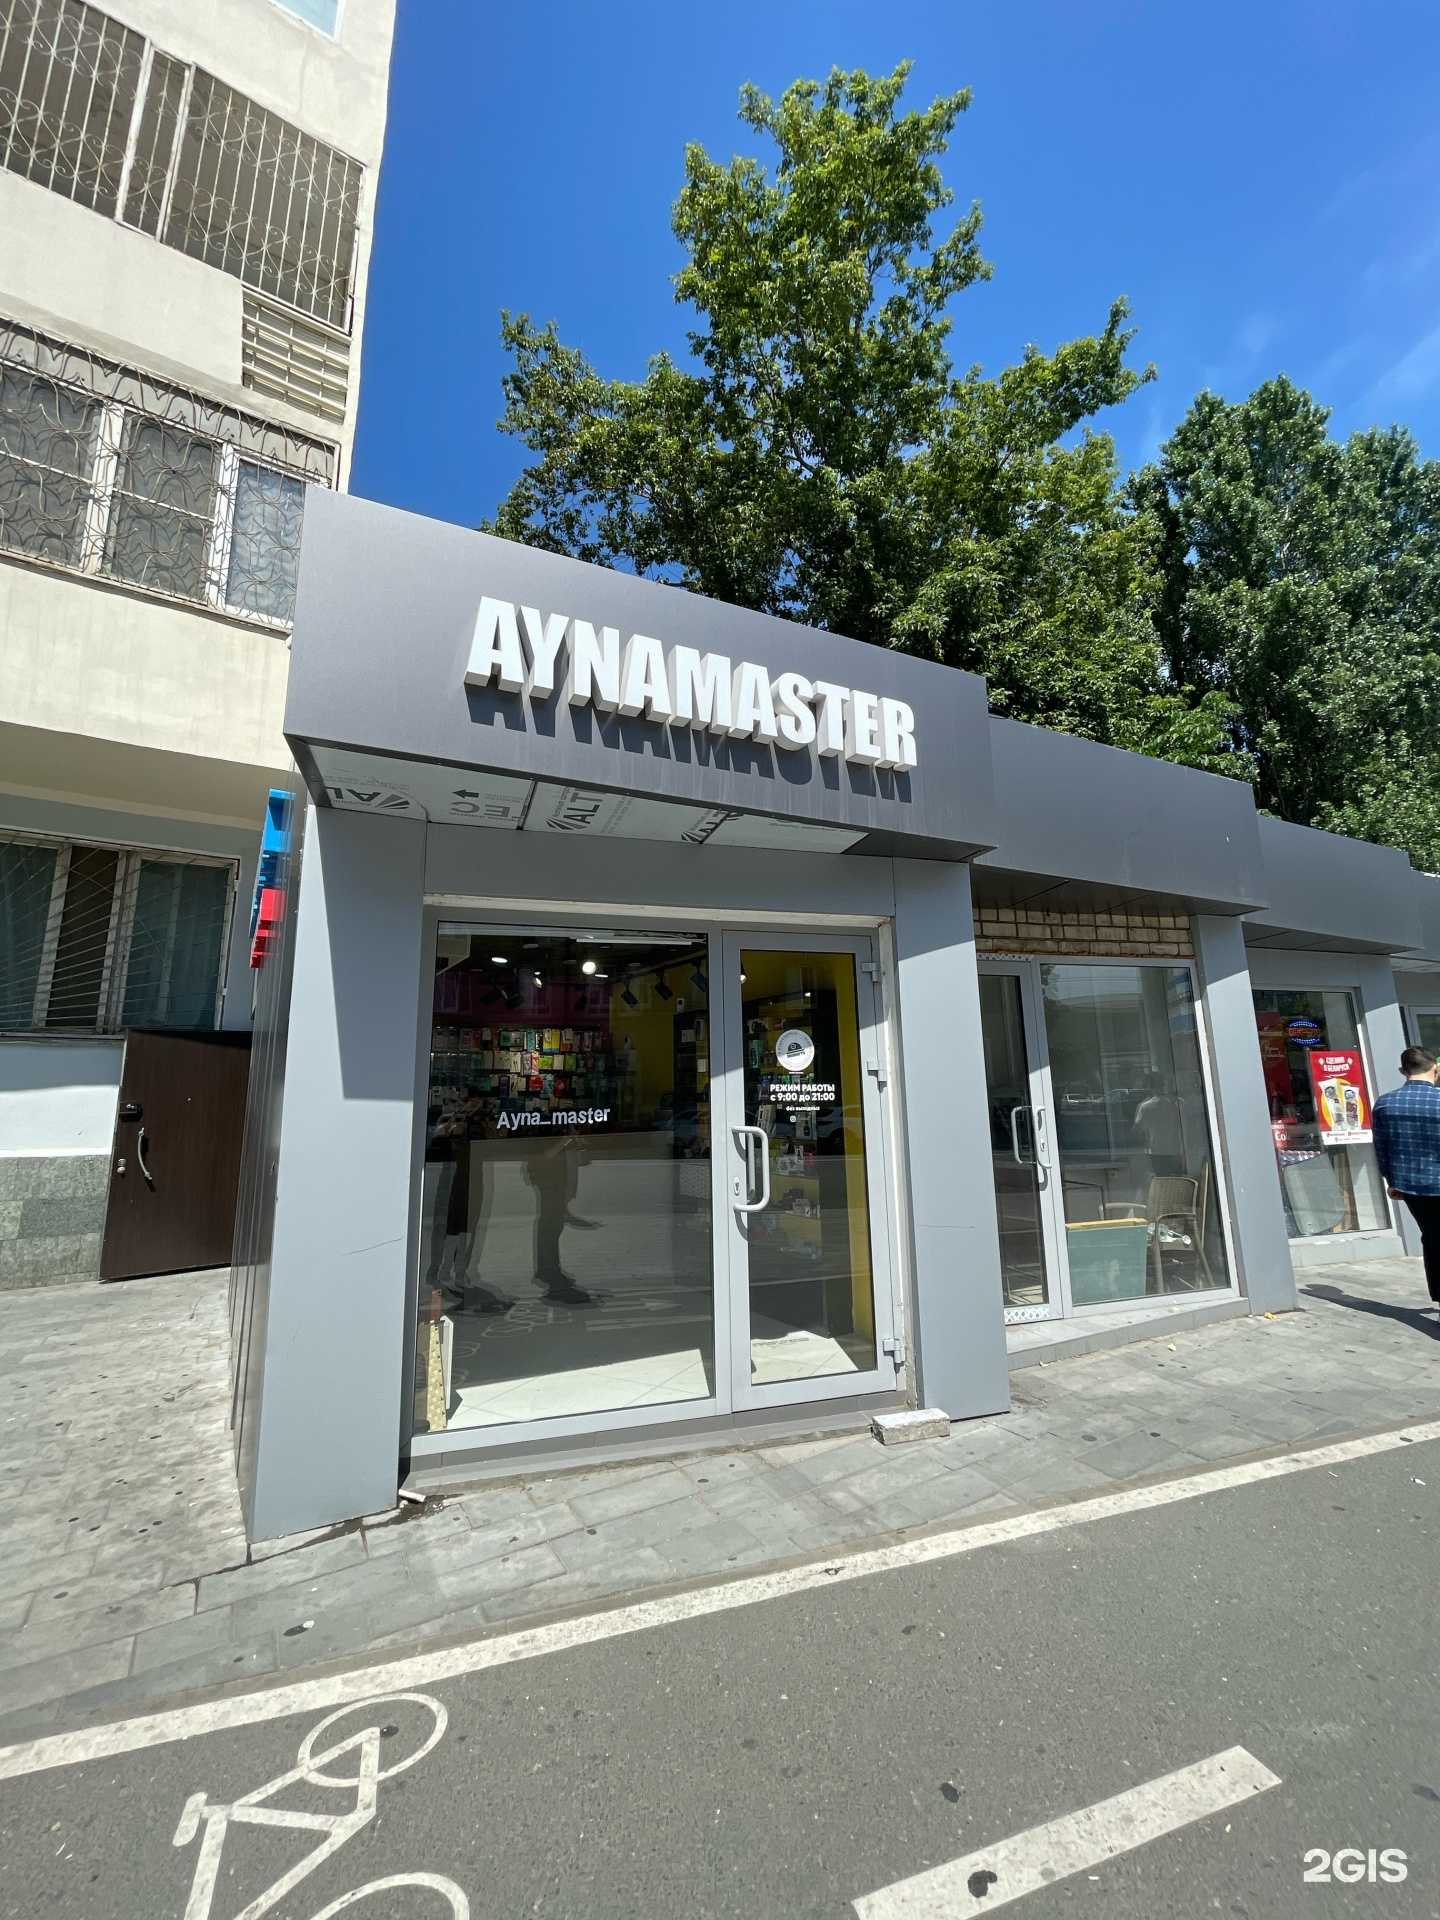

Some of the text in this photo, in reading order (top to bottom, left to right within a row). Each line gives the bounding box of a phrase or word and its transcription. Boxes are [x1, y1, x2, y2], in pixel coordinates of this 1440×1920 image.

[465, 597, 917, 771] AYNAMASTER
[770, 1084, 835, 1092] РЕЖИМ РАБОТЫ
[777, 1092, 797, 1101] 9:00
[811, 1092, 835, 1101] 21:00
[497, 1107, 611, 1130] Ayna_master
